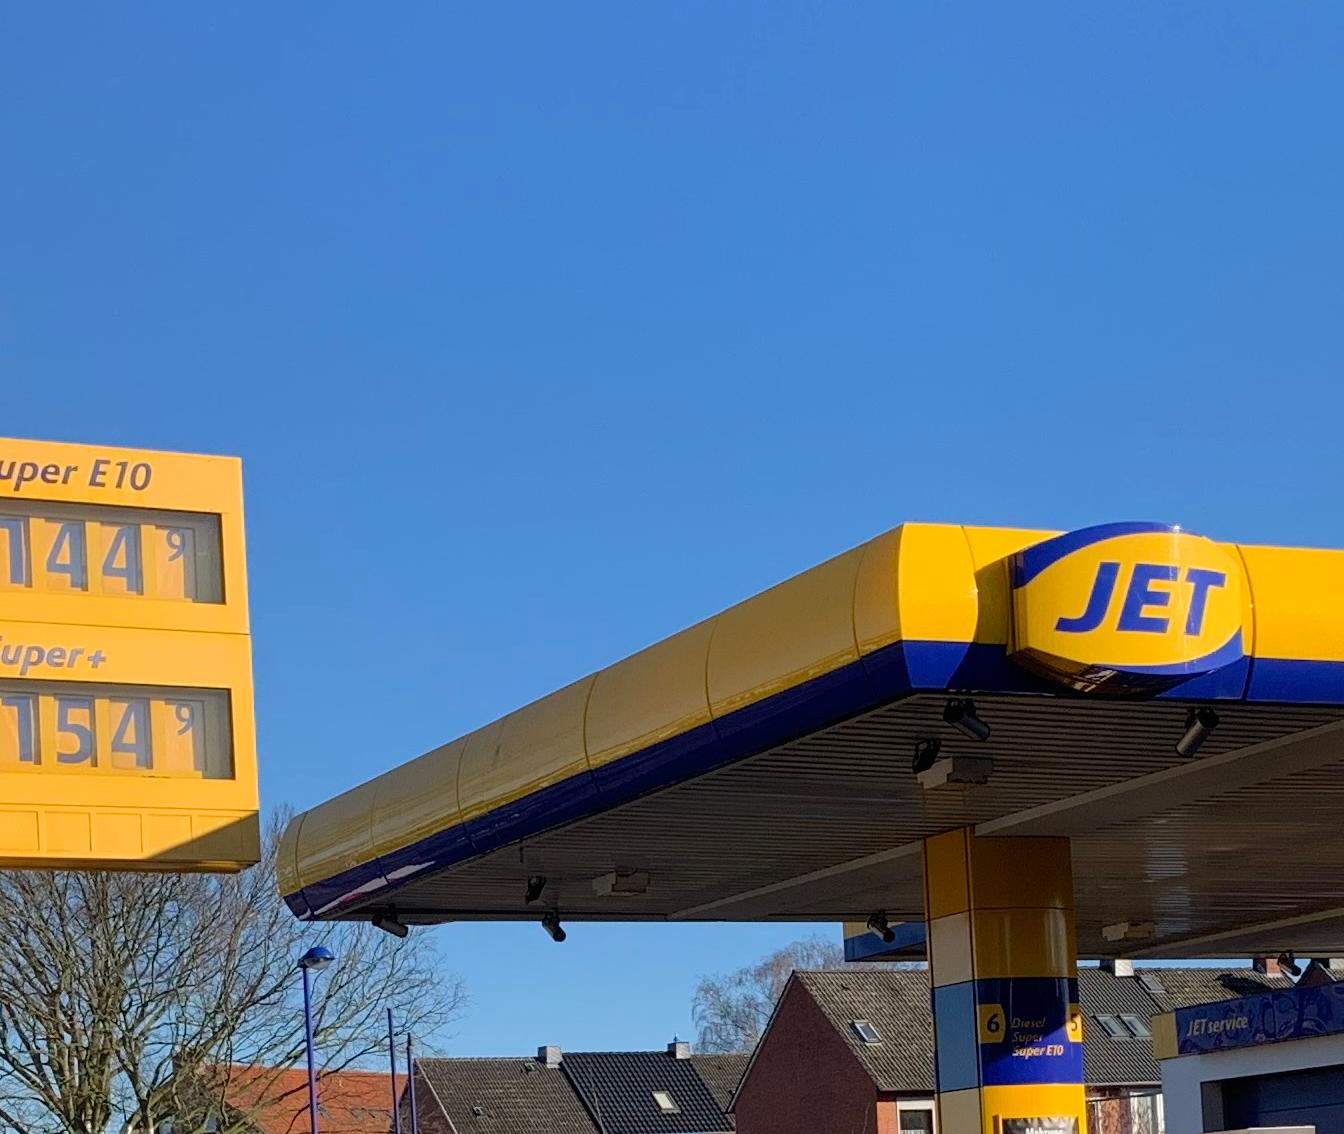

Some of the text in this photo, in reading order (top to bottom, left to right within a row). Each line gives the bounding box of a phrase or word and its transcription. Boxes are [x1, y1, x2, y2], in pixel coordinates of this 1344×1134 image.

[89, 459, 152, 491] E10
[1055, 562, 1226, 636] JET
[987, 1013, 1000, 1033] 6
[1012, 1017, 1046, 1028] Diesel
[1070, 1013, 1078, 1032] 5
[1013, 1031, 1042, 1043] Super
[1012, 1044, 1064, 1059] Super E10
